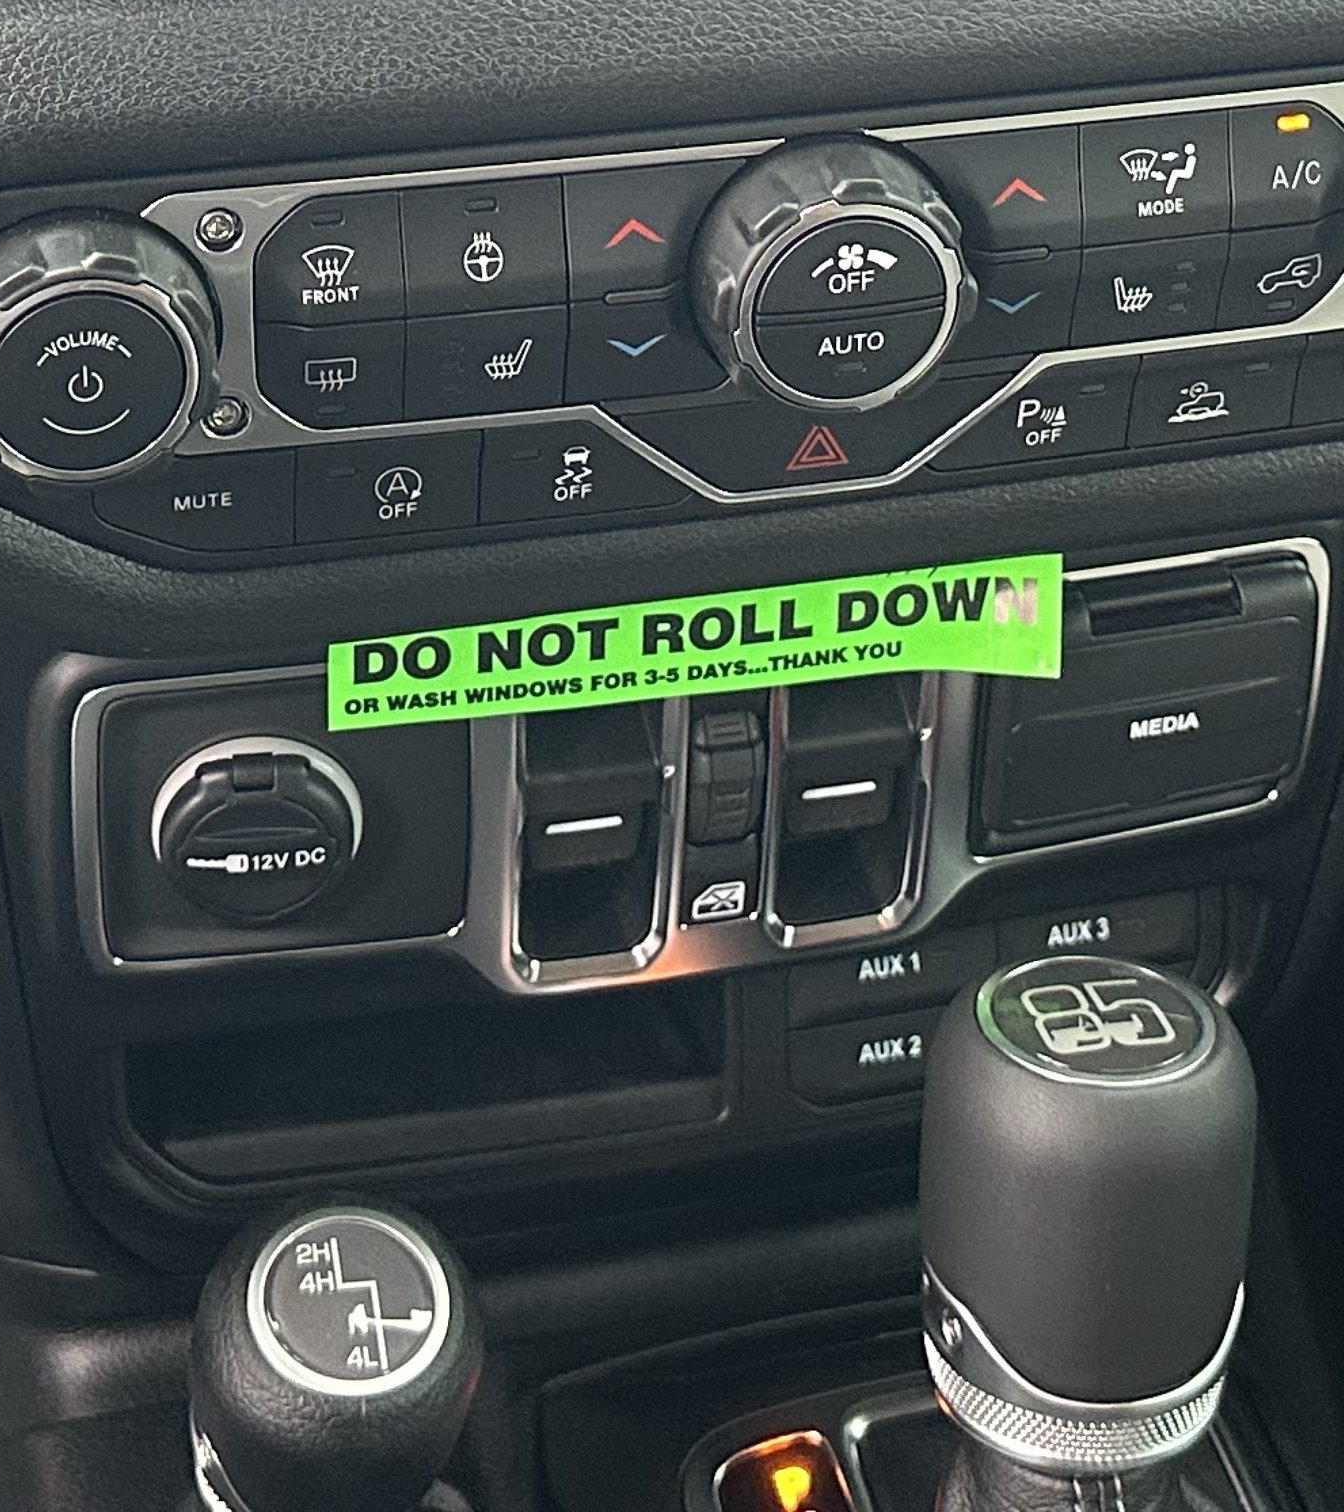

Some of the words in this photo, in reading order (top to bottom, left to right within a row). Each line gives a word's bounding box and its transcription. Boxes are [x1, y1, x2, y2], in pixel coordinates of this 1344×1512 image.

[1271, 161, 1323, 191] A/C
[1138, 197, 1185, 218] MODE
[828, 270, 875, 294] OFF
[302, 286, 360, 306] FRONT
[43, 330, 120, 358] VOLUME
[818, 331, 886, 357] AUTO
[1025, 430, 1063, 447] OFF
[173, 491, 233, 512] MUTE
[553, 482, 593, 502] OFF
[378, 501, 419, 521] OFF
[353, 636, 451, 686] DO
[476, 619, 619, 674] NOT
[641, 598, 814, 656] ROLL
[837, 576, 1039, 634] DOWN
[344, 697, 381, 717] OR
[386, 689, 459, 712] WASH
[465, 676, 584, 705] WINDOWS
[590, 668, 639, 691] FOR
[643, 664, 681, 686] 3-5
[853, 639, 903, 661] YOU
[1129, 712, 1200, 741] MEDIA
[251, 852, 290, 871] 12V
[295, 847, 327, 866] DC
[1047, 919, 1093, 948] AUX
[1095, 916, 1111, 940] 3
[858, 955, 904, 982] AUX
[909, 951, 922, 975] 1
[1020, 978, 1176, 1056] 85
[859, 1039, 905, 1067] AUX
[906, 1035, 923, 1059] 2
[296, 1242, 331, 1265] 2H
[299, 1271, 336, 1294] 4H
[346, 1346, 379, 1369] 4L
